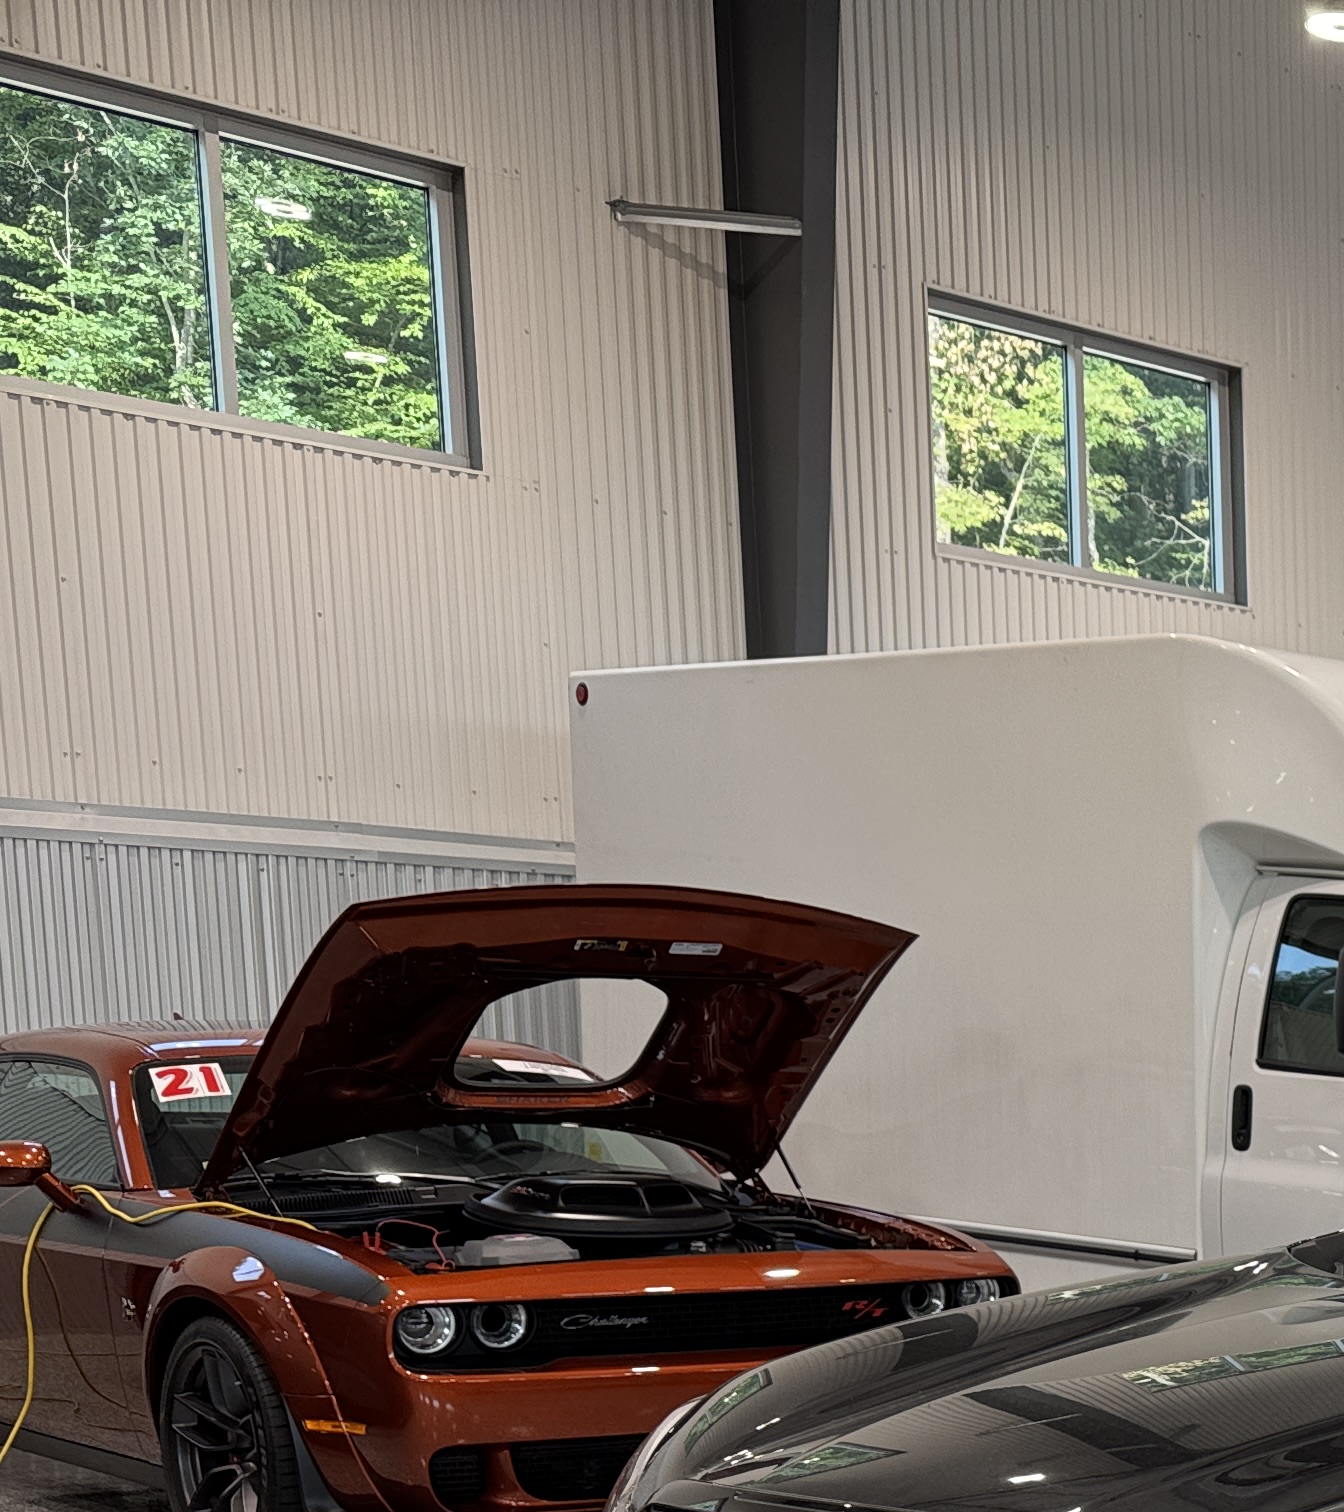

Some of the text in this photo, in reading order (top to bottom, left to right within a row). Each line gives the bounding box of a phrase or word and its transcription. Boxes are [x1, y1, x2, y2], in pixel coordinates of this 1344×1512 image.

[155, 1066, 222, 1097] 21
[841, 1298, 889, 1319] R/T
[560, 1314, 649, 1329] Challenger
